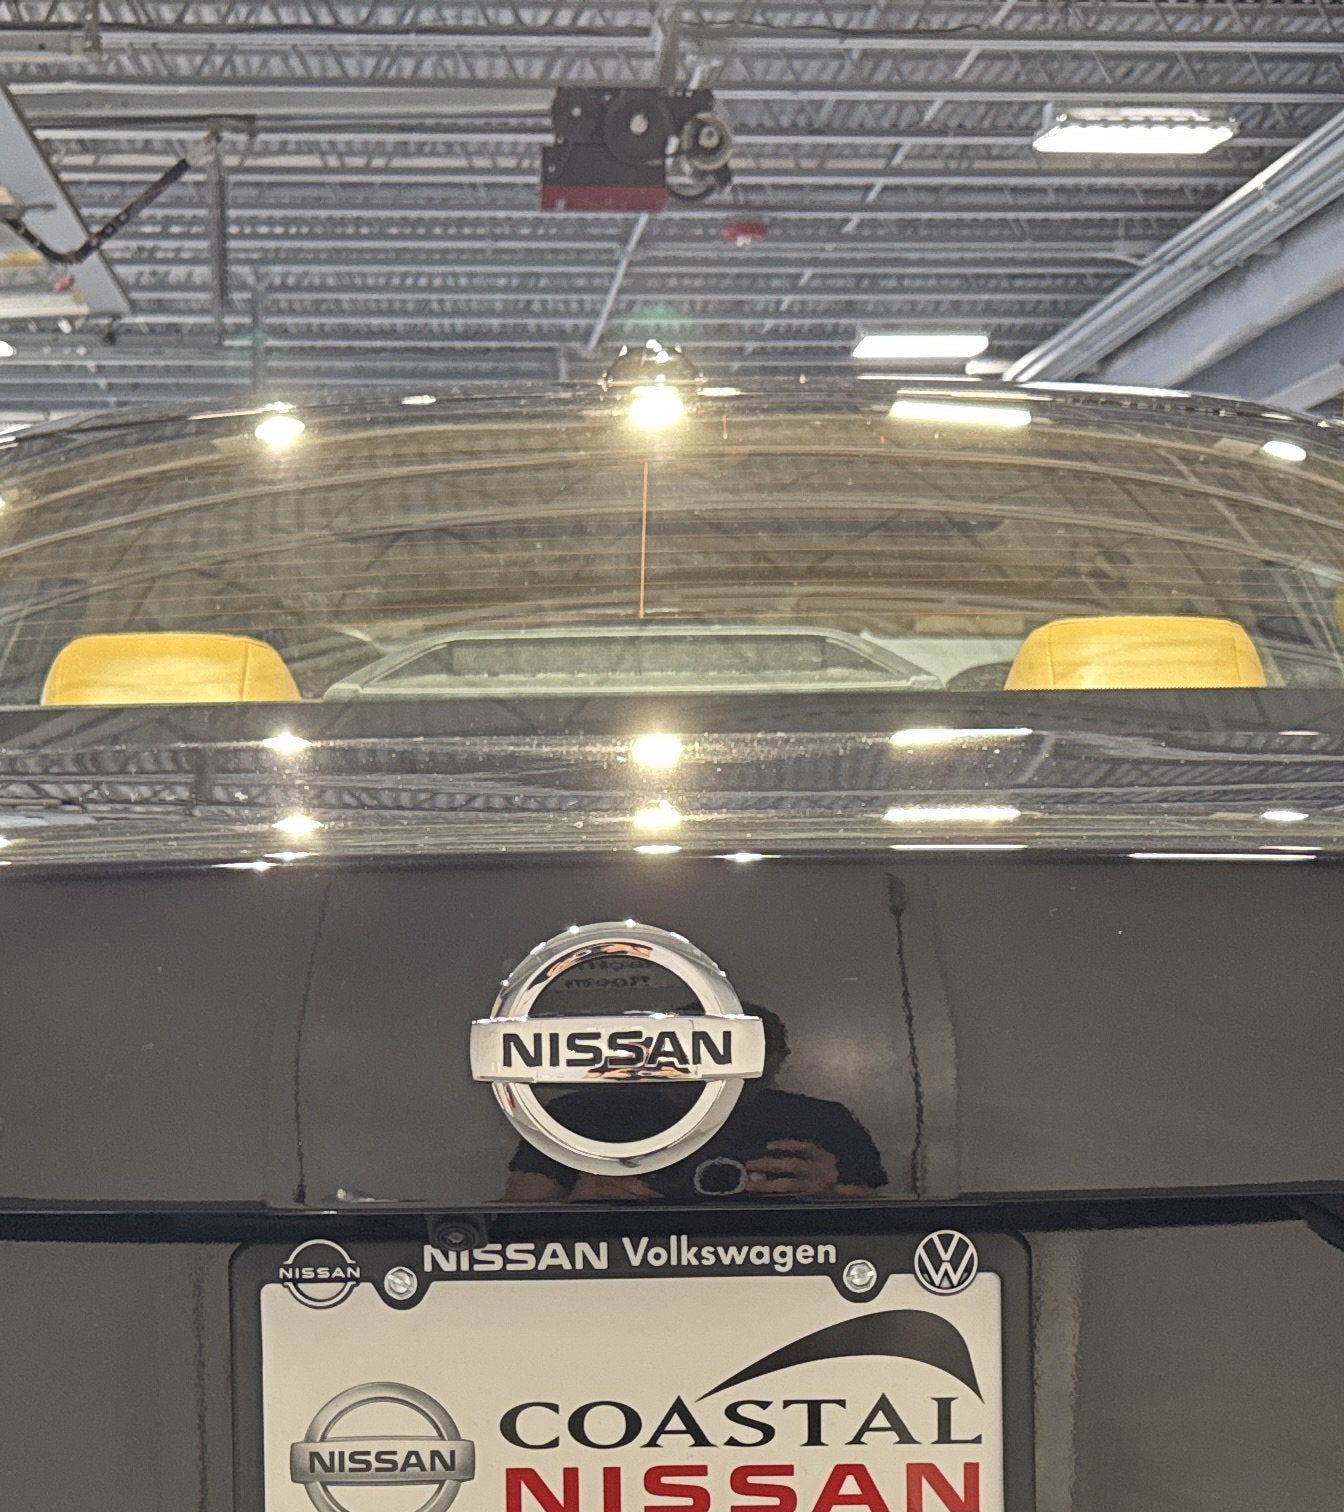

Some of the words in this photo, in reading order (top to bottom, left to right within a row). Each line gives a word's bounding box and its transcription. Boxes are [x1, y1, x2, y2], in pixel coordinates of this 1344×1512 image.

[502, 1030, 733, 1069] NISSAN
[278, 1266, 361, 1280] NISSAN
[423, 1241, 609, 1273] NISSAN
[621, 1234, 837, 1273] Volkswagen
[499, 1391, 983, 1450] COASTAL
[308, 1449, 456, 1474] NISSAN
